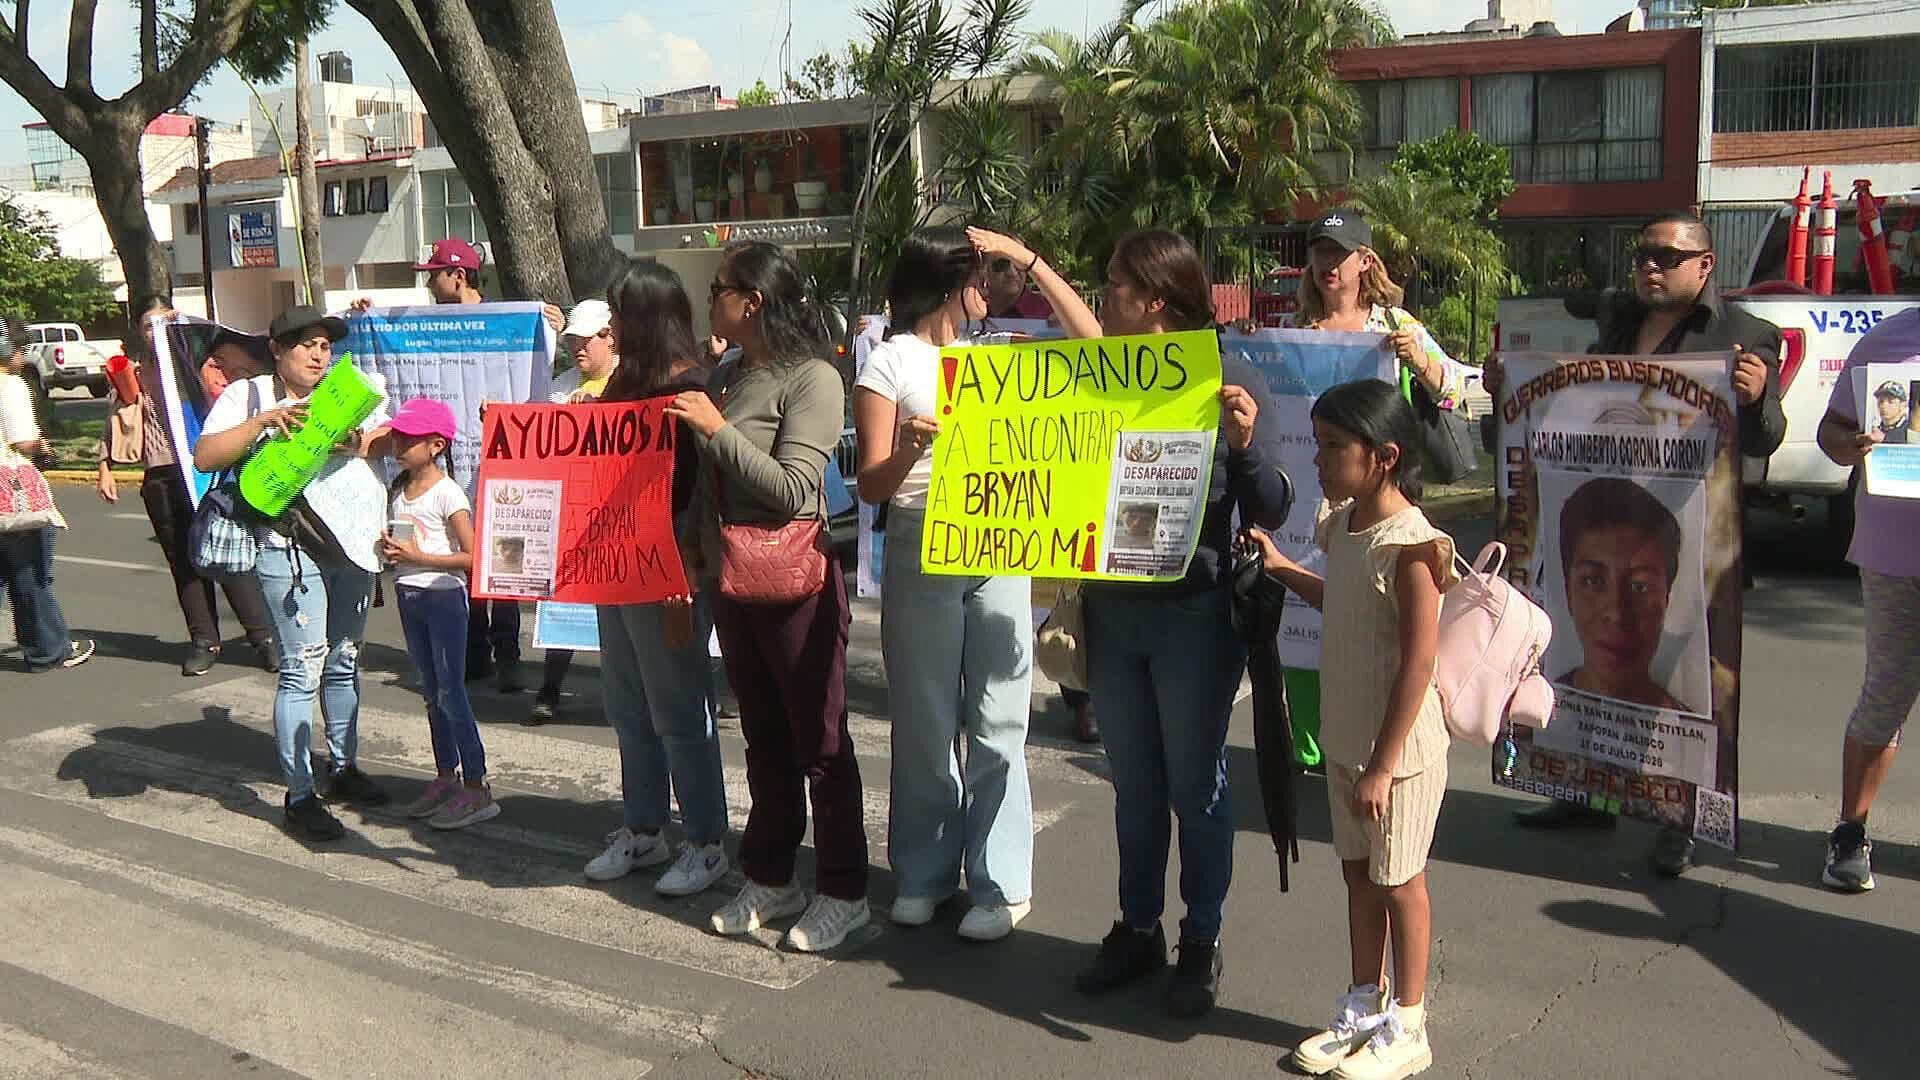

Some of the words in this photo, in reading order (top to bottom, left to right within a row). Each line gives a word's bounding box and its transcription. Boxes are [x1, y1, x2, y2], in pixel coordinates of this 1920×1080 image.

[1324, 213, 1344, 226] alo
[373, 323, 393, 332] VIO
[395, 322, 418, 332] POR
[420, 319, 462, 332] ÚLTIMA
[464, 320, 486, 331] VEZ
[1504, 360, 1604, 424] GUERREROS
[486, 405, 651, 459] AYUDANOS
[944, 421, 969, 466] A
[990, 410, 1123, 465] ENCONTRAR
[1532, 432, 1563, 460] CARLOS
[1566, 432, 1616, 464] HUMBERTO
[1619, 435, 1661, 468] CORONA
[1124, 467, 1198, 480] DESAPARECIDO
[933, 475, 948, 512] A
[963, 469, 1051, 521] BRYAN
[496, 508, 551, 520] DESAPARECIDO
[586, 506, 636, 543] BRYAN
[928, 520, 1042, 571] EDUARDO
[562, 542, 628, 584] EDUARDO
[1283, 625, 1320, 641] JALIS
[1622, 731, 1665, 750] JALISCO
[1638, 719, 1708, 744] TEPETITLAN,
[1593, 742, 1606, 754] DE
[1608, 745, 1637, 761] JULIO
